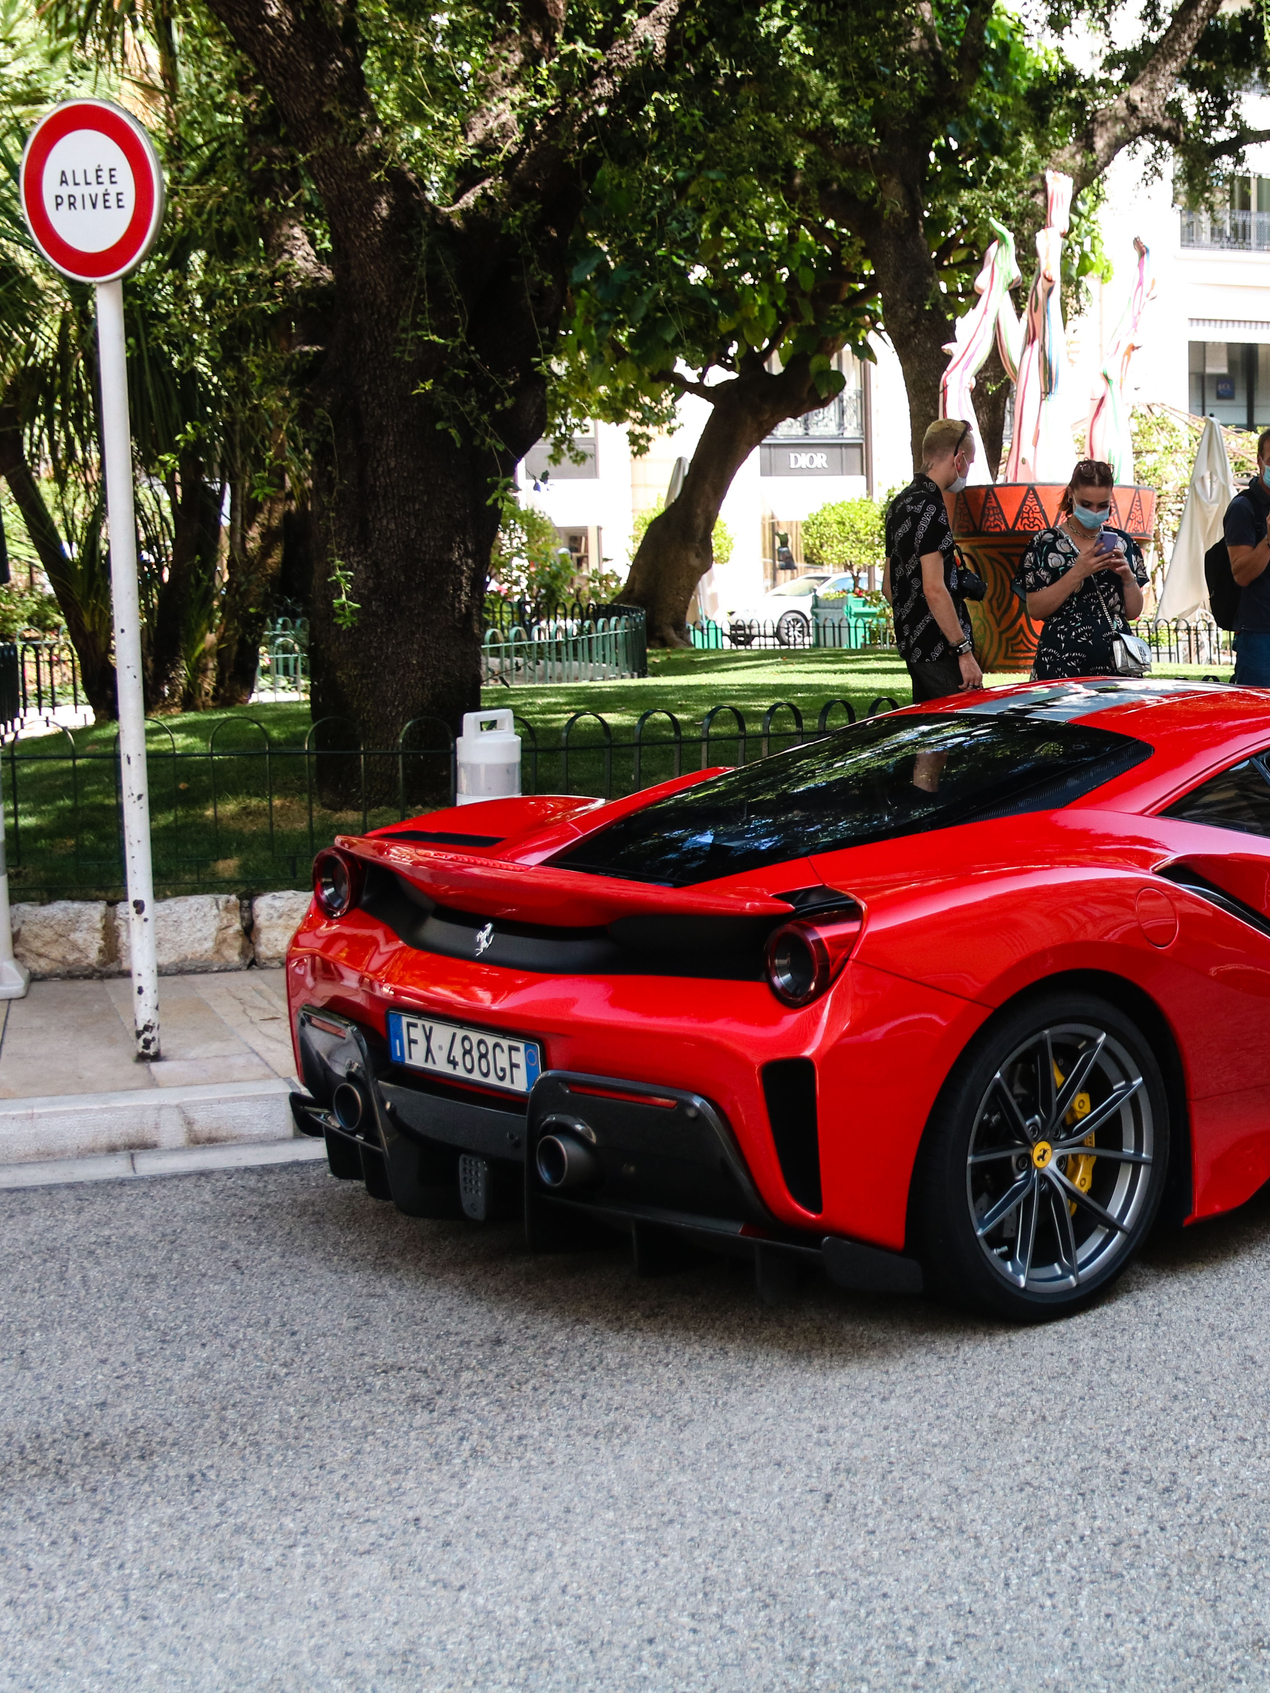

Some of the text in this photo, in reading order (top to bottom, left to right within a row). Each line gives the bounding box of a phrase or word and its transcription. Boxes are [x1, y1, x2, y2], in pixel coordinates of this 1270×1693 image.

[60, 164, 118, 187] ALLÉE
[54, 188, 125, 211] PRIVÉE
[789, 452, 829, 469] DIOR
[406, 1021, 522, 1085] FX 488GF
